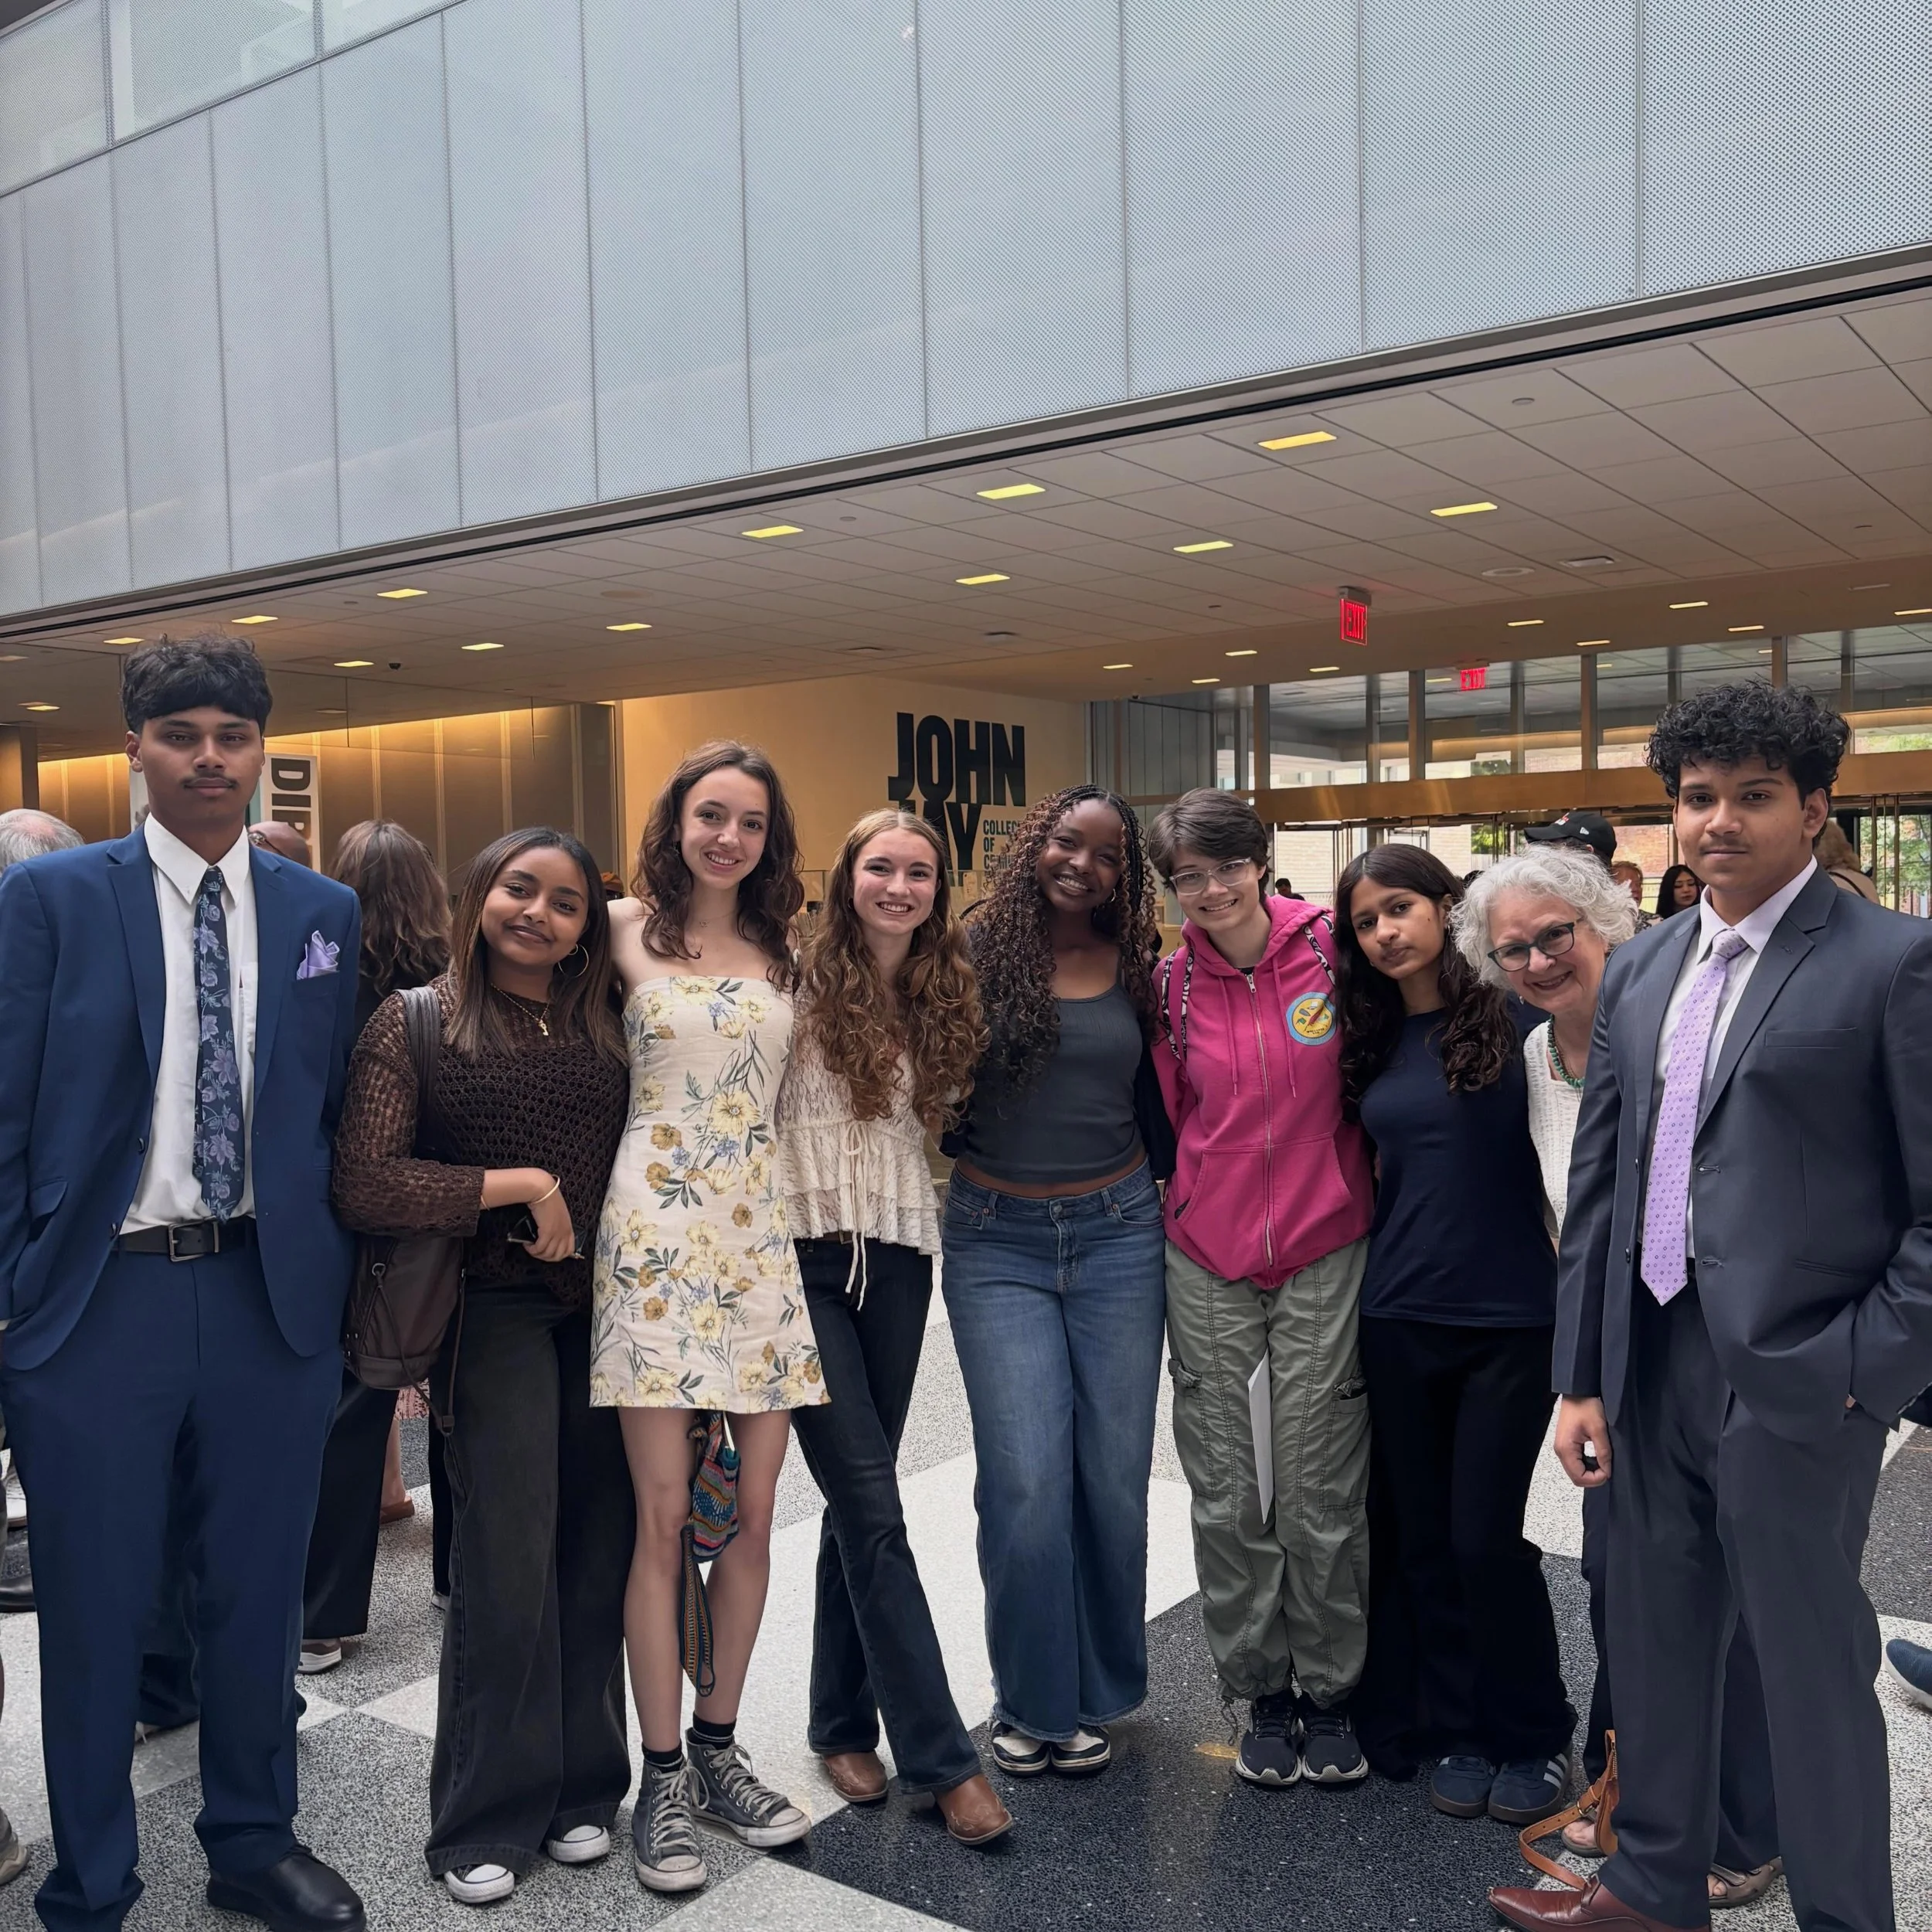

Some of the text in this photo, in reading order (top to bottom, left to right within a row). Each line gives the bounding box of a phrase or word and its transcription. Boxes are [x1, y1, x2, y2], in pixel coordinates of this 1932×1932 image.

[1346, 602, 1364, 640] EXIT
[1461, 668, 1485, 691] EXIT
[888, 712, 1026, 807] JOHN
[896, 799, 983, 886] AY
[983, 836, 995, 852] OF
